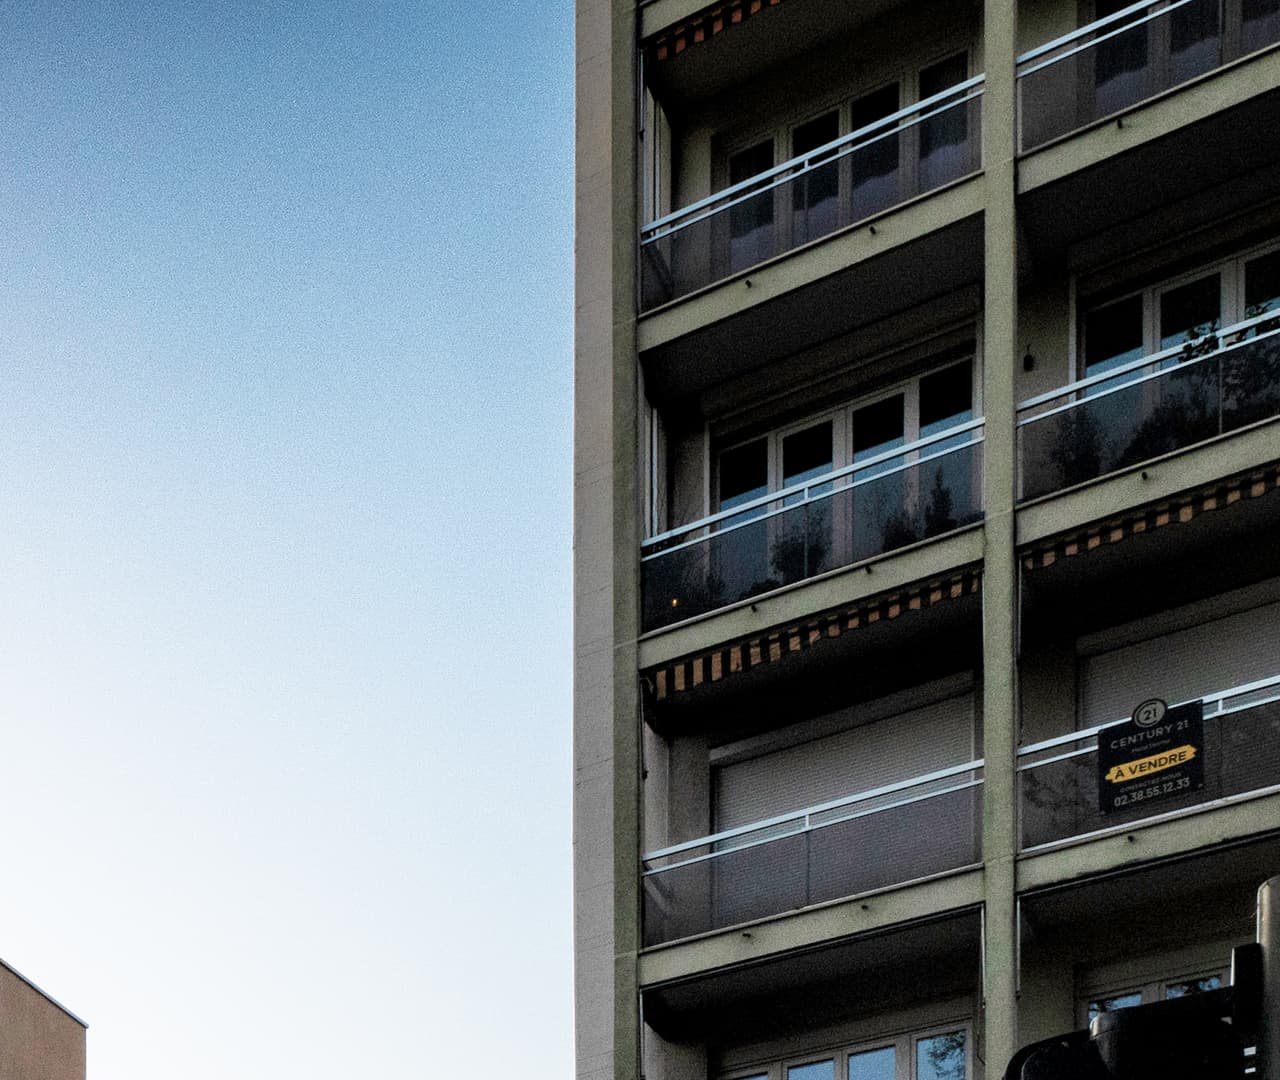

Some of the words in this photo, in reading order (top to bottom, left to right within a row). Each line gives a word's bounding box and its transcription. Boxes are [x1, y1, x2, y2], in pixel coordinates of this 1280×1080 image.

[1144, 708, 1158, 720] 21
[1110, 724, 1173, 749] CENTURY
[1177, 719, 1189, 730] 21
[1114, 766, 1125, 779] À
[1128, 751, 1187, 775] VENDRE
[1114, 777, 1190, 807] 02.38.55.12.33
